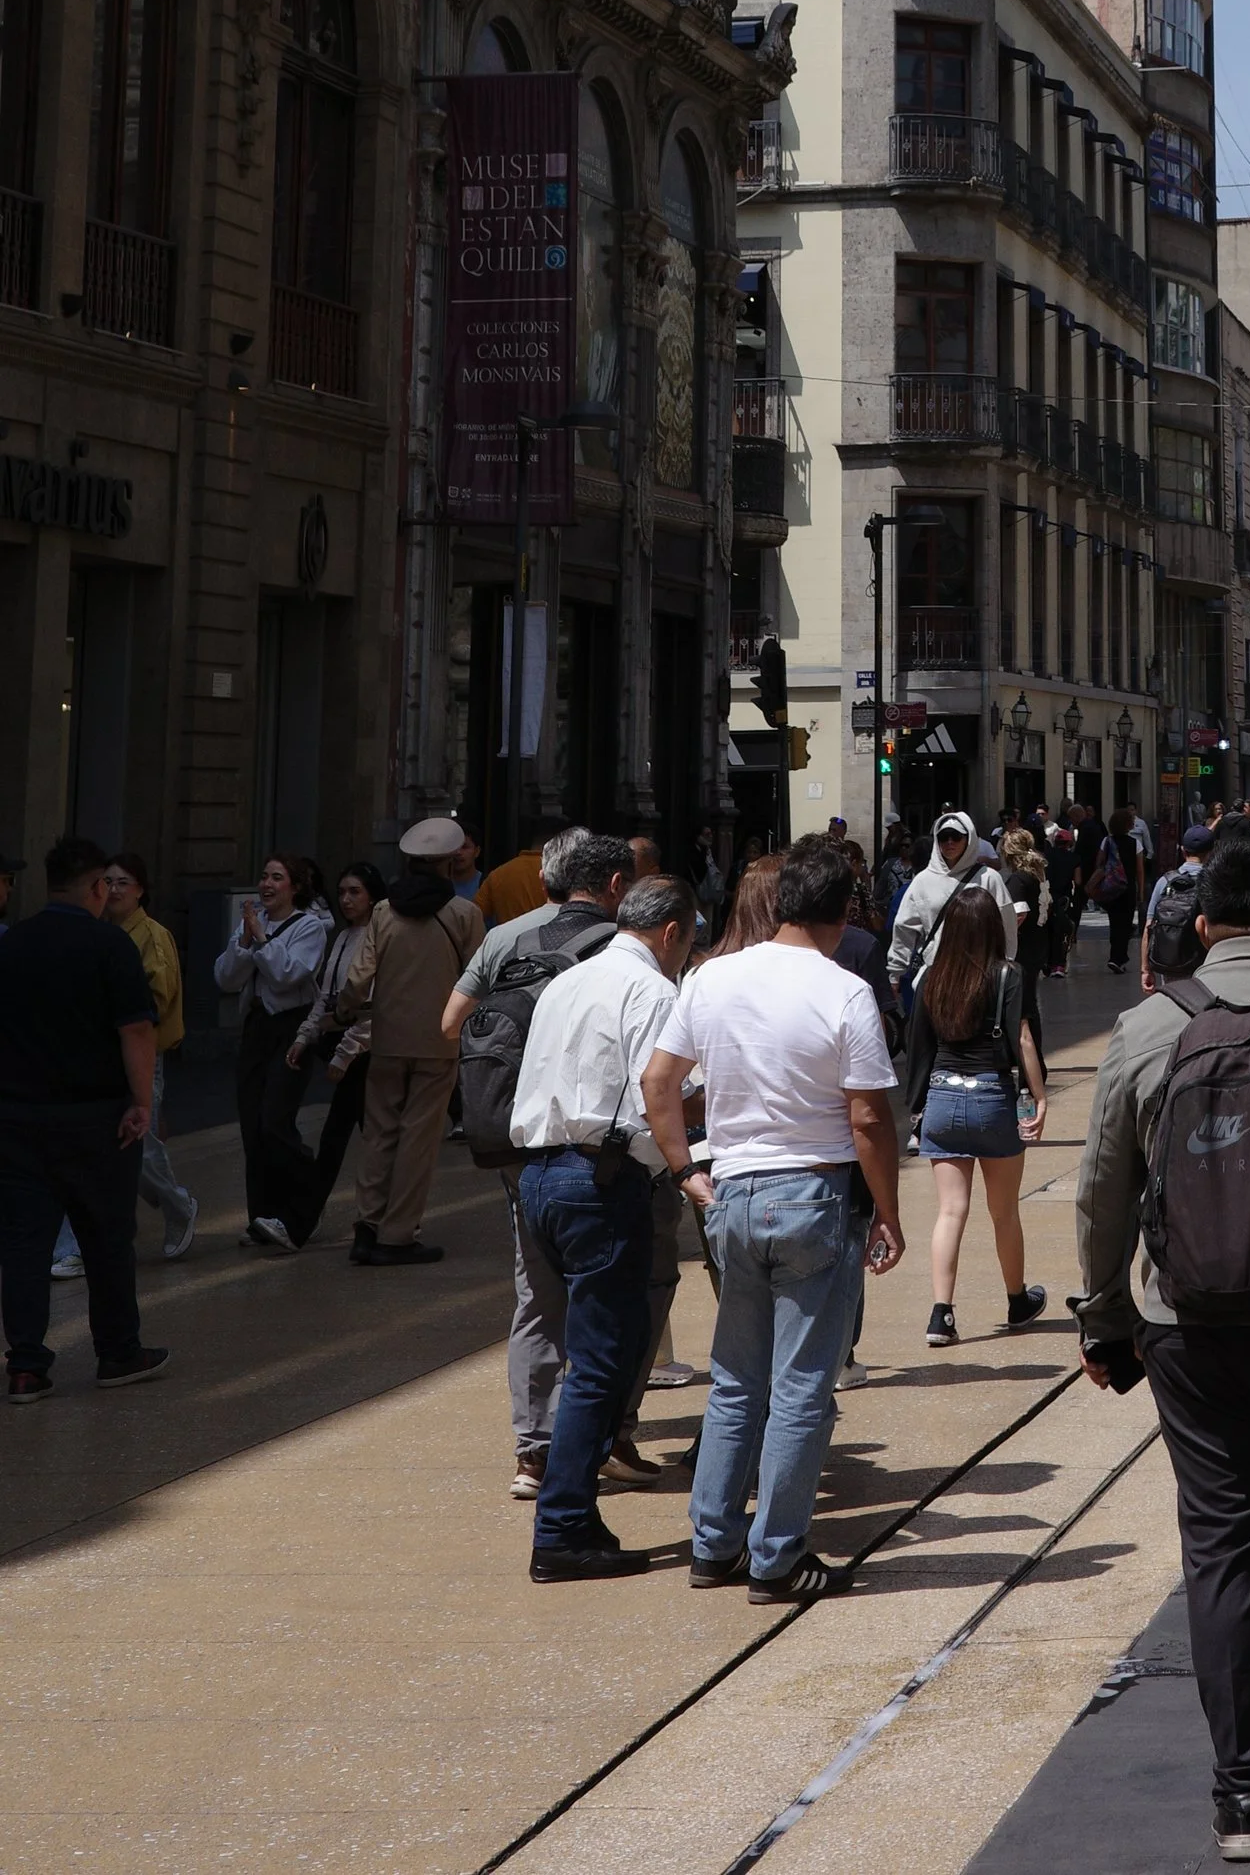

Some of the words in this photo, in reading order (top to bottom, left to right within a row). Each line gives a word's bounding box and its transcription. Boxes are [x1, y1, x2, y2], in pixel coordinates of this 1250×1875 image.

[489, 185, 543, 210] DEL
[460, 215, 565, 242] ESTAN
[466, 321, 560, 335] COLECCIONES
[476, 342, 549, 359] CARLOS
[462, 361, 561, 383] MONSIVÁIS
[474, 454, 513, 462] ENTRADA
[515, 454, 540, 462] LRE
[1197, 1113, 1245, 1139] NIKE
